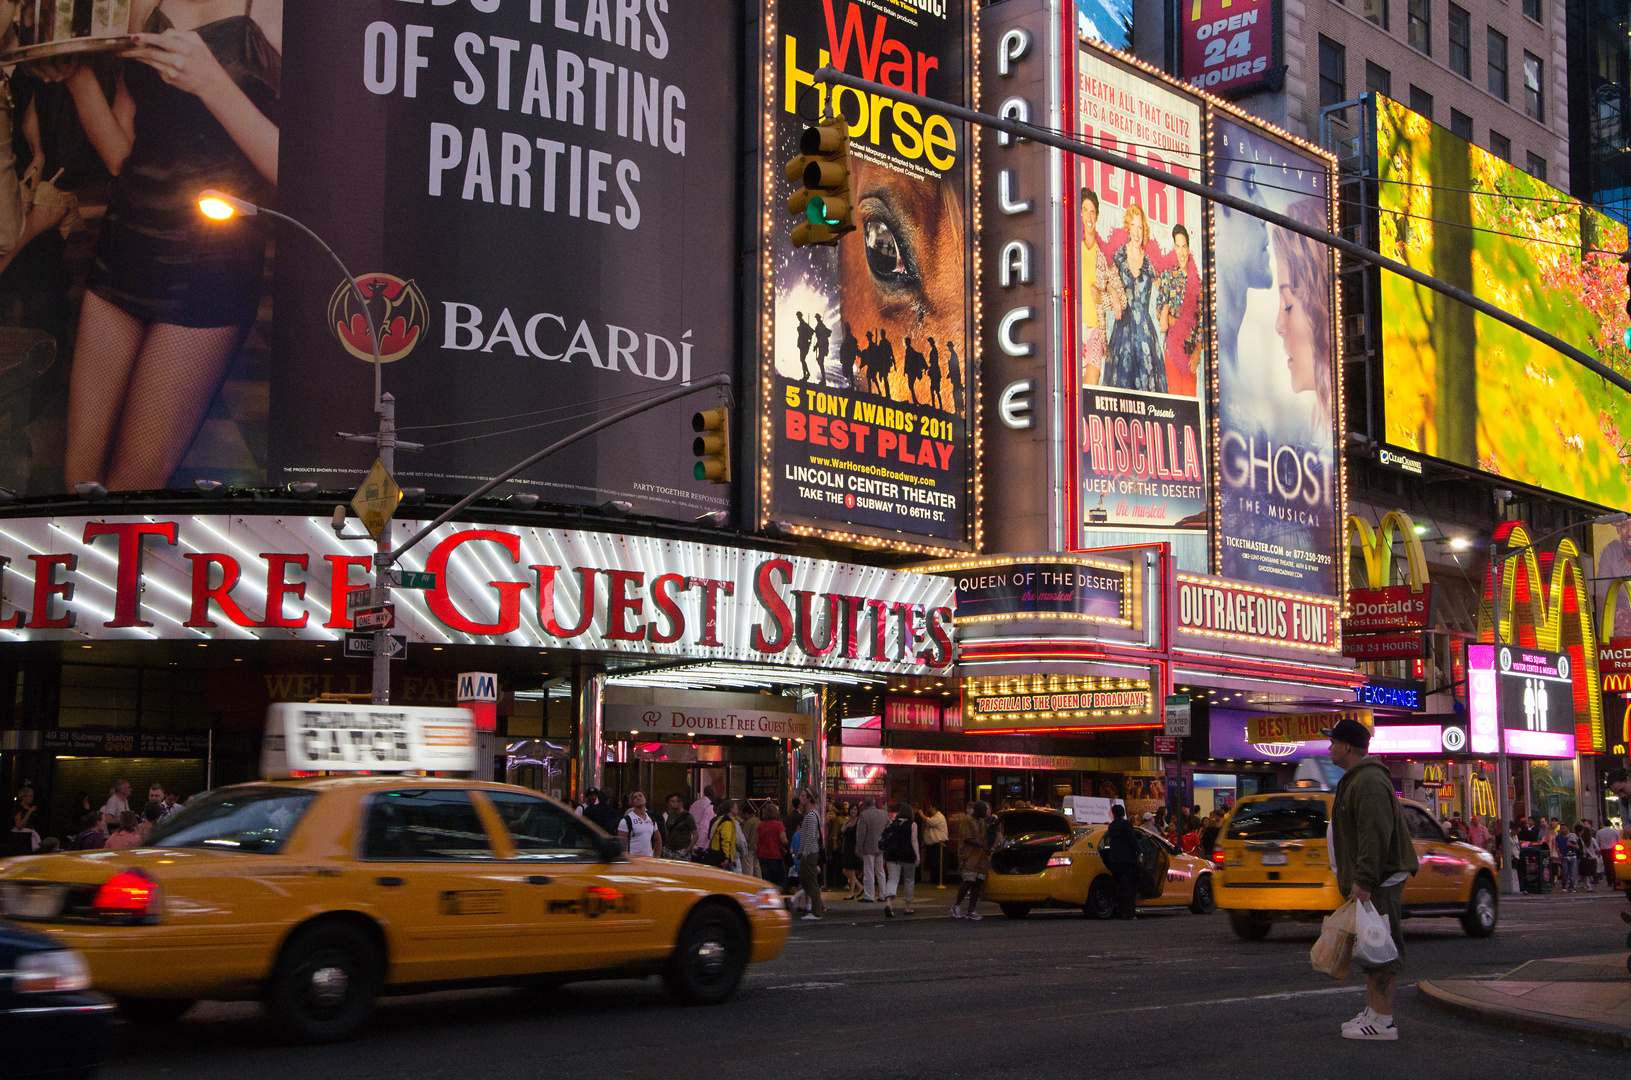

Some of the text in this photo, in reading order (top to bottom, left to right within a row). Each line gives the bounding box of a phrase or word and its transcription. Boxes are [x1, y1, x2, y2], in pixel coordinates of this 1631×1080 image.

[530, 0, 669, 59] ARS
[897, 13, 918, 27] production
[1196, 9, 1258, 40] OPEN
[823, 0, 939, 97] War
[1204, 30, 1251, 68] 24
[1191, 56, 1267, 88] HOURS
[363, 21, 686, 156] OF STARTING
[785, 34, 957, 171] Horse
[1119, 91, 1135, 114] ALL
[1139, 100, 1161, 125] THAT
[1165, 113, 1189, 139] GLITZ
[1101, 107, 1106, 122] A
[1109, 109, 1133, 135] GREAT
[1137, 123, 1150, 141] BIG
[1152, 131, 1190, 159] SEQUINED
[429, 122, 641, 230] PARTIES
[854, 151, 924, 181] with Handspring Puppet Company
[891, 155, 908, 167] adapted
[909, 162, 914, 170] by
[915, 163, 925, 173] Nick
[925, 168, 941, 179] Stafford
[1224, 135, 1316, 187] BELIEVE
[997, 27, 1034, 430] PALACE
[440, 301, 694, 387] BACARDÍ
[786, 385, 800, 407] 5
[806, 389, 849, 417] TONY
[920, 416, 953, 441] 2011
[1095, 395, 1175, 418] BETTE MIDLER Presents
[786, 410, 954, 471] BEST PLAY
[810, 456, 936, 487] www.WarHorseOnBroadway.com
[1221, 430, 1333, 508] GHOST
[633, 482, 655, 492] PARTY
[655, 485, 690, 498] TOGETHER
[691, 489, 731, 506] RESPONSIBLY.
[785, 464, 956, 510] LINCOLN CENTER THEATER
[1083, 479, 1201, 499] UEEN OF THE DESERT
[799, 486, 823, 501] TAKE
[825, 491, 843, 504] THE
[856, 497, 893, 513] SUBWAY
[895, 503, 908, 515] TO
[909, 506, 931, 519] 66TH
[933, 511, 946, 522] ST.
[1116, 498, 1167, 519] the musical
[1240, 497, 1320, 527] THE MUSICAL
[1226, 536, 1284, 556] TICKETMASTER.COM
[1293, 549, 1332, 565] 877-250-2929
[407, 573, 417, 586] 7
[959, 572, 1119, 593] QUEEN OF THE DESERT
[424, 529, 735, 646] GUEST
[750, 558, 954, 668] SUITES
[359, 613, 389, 626] ONE WAY
[1180, 584, 1328, 645] OUTRAGEOUS FUN!
[1346, 615, 1408, 627] Restaurant
[354, 640, 371, 649] ONE
[1367, 643, 1379, 652] 24
[1382, 641, 1418, 651] HOURS
[264, 674, 367, 698] WELL
[1365, 686, 1418, 708] EXCHANGE
[892, 702, 911, 724] THE
[915, 703, 934, 725] TWO
[1022, 698, 1031, 710] IS
[1033, 697, 1050, 709] THE
[1051, 695, 1079, 711] QUEEN
[1081, 694, 1092, 707] OF
[72, 732, 102, 743] Subway
[105, 733, 134, 742] Station
[1258, 717, 1292, 737] BEST
[942, 753, 951, 764] ALL
[953, 754, 966, 764] THAT
[968, 754, 982, 765] GLITZ
[984, 755, 999, 765] BEATS
[1005, 755, 1020, 766] GREAT
[1022, 756, 1031, 767] BIG
